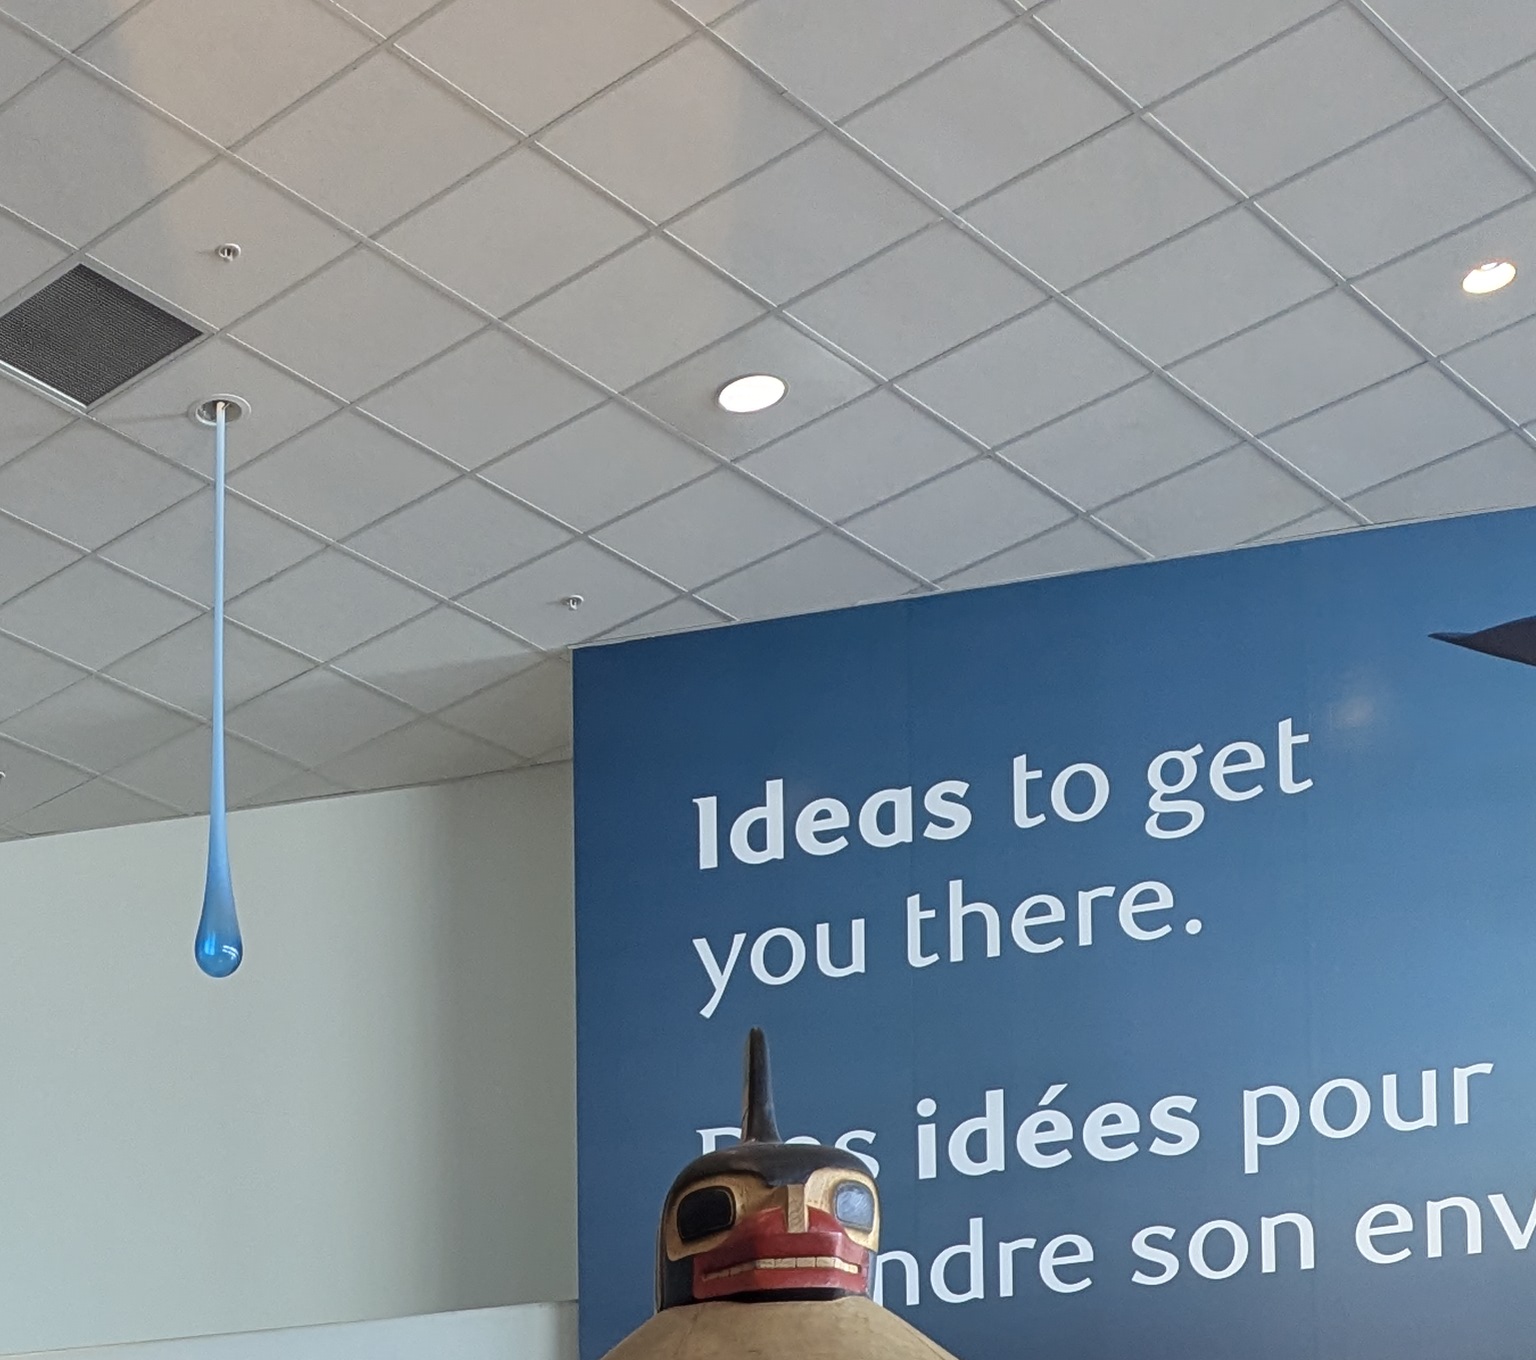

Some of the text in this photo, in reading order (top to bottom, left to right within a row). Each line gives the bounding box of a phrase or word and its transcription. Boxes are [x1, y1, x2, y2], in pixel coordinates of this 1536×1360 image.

[692, 718, 1313, 870] Ideas to get
[692, 879, 1204, 1018] you there.
[916, 1083, 1201, 1180] idées
[1243, 1062, 1494, 1174] pour
[872, 1217, 1094, 1307] ndre
[1131, 1212, 1315, 1286] son
